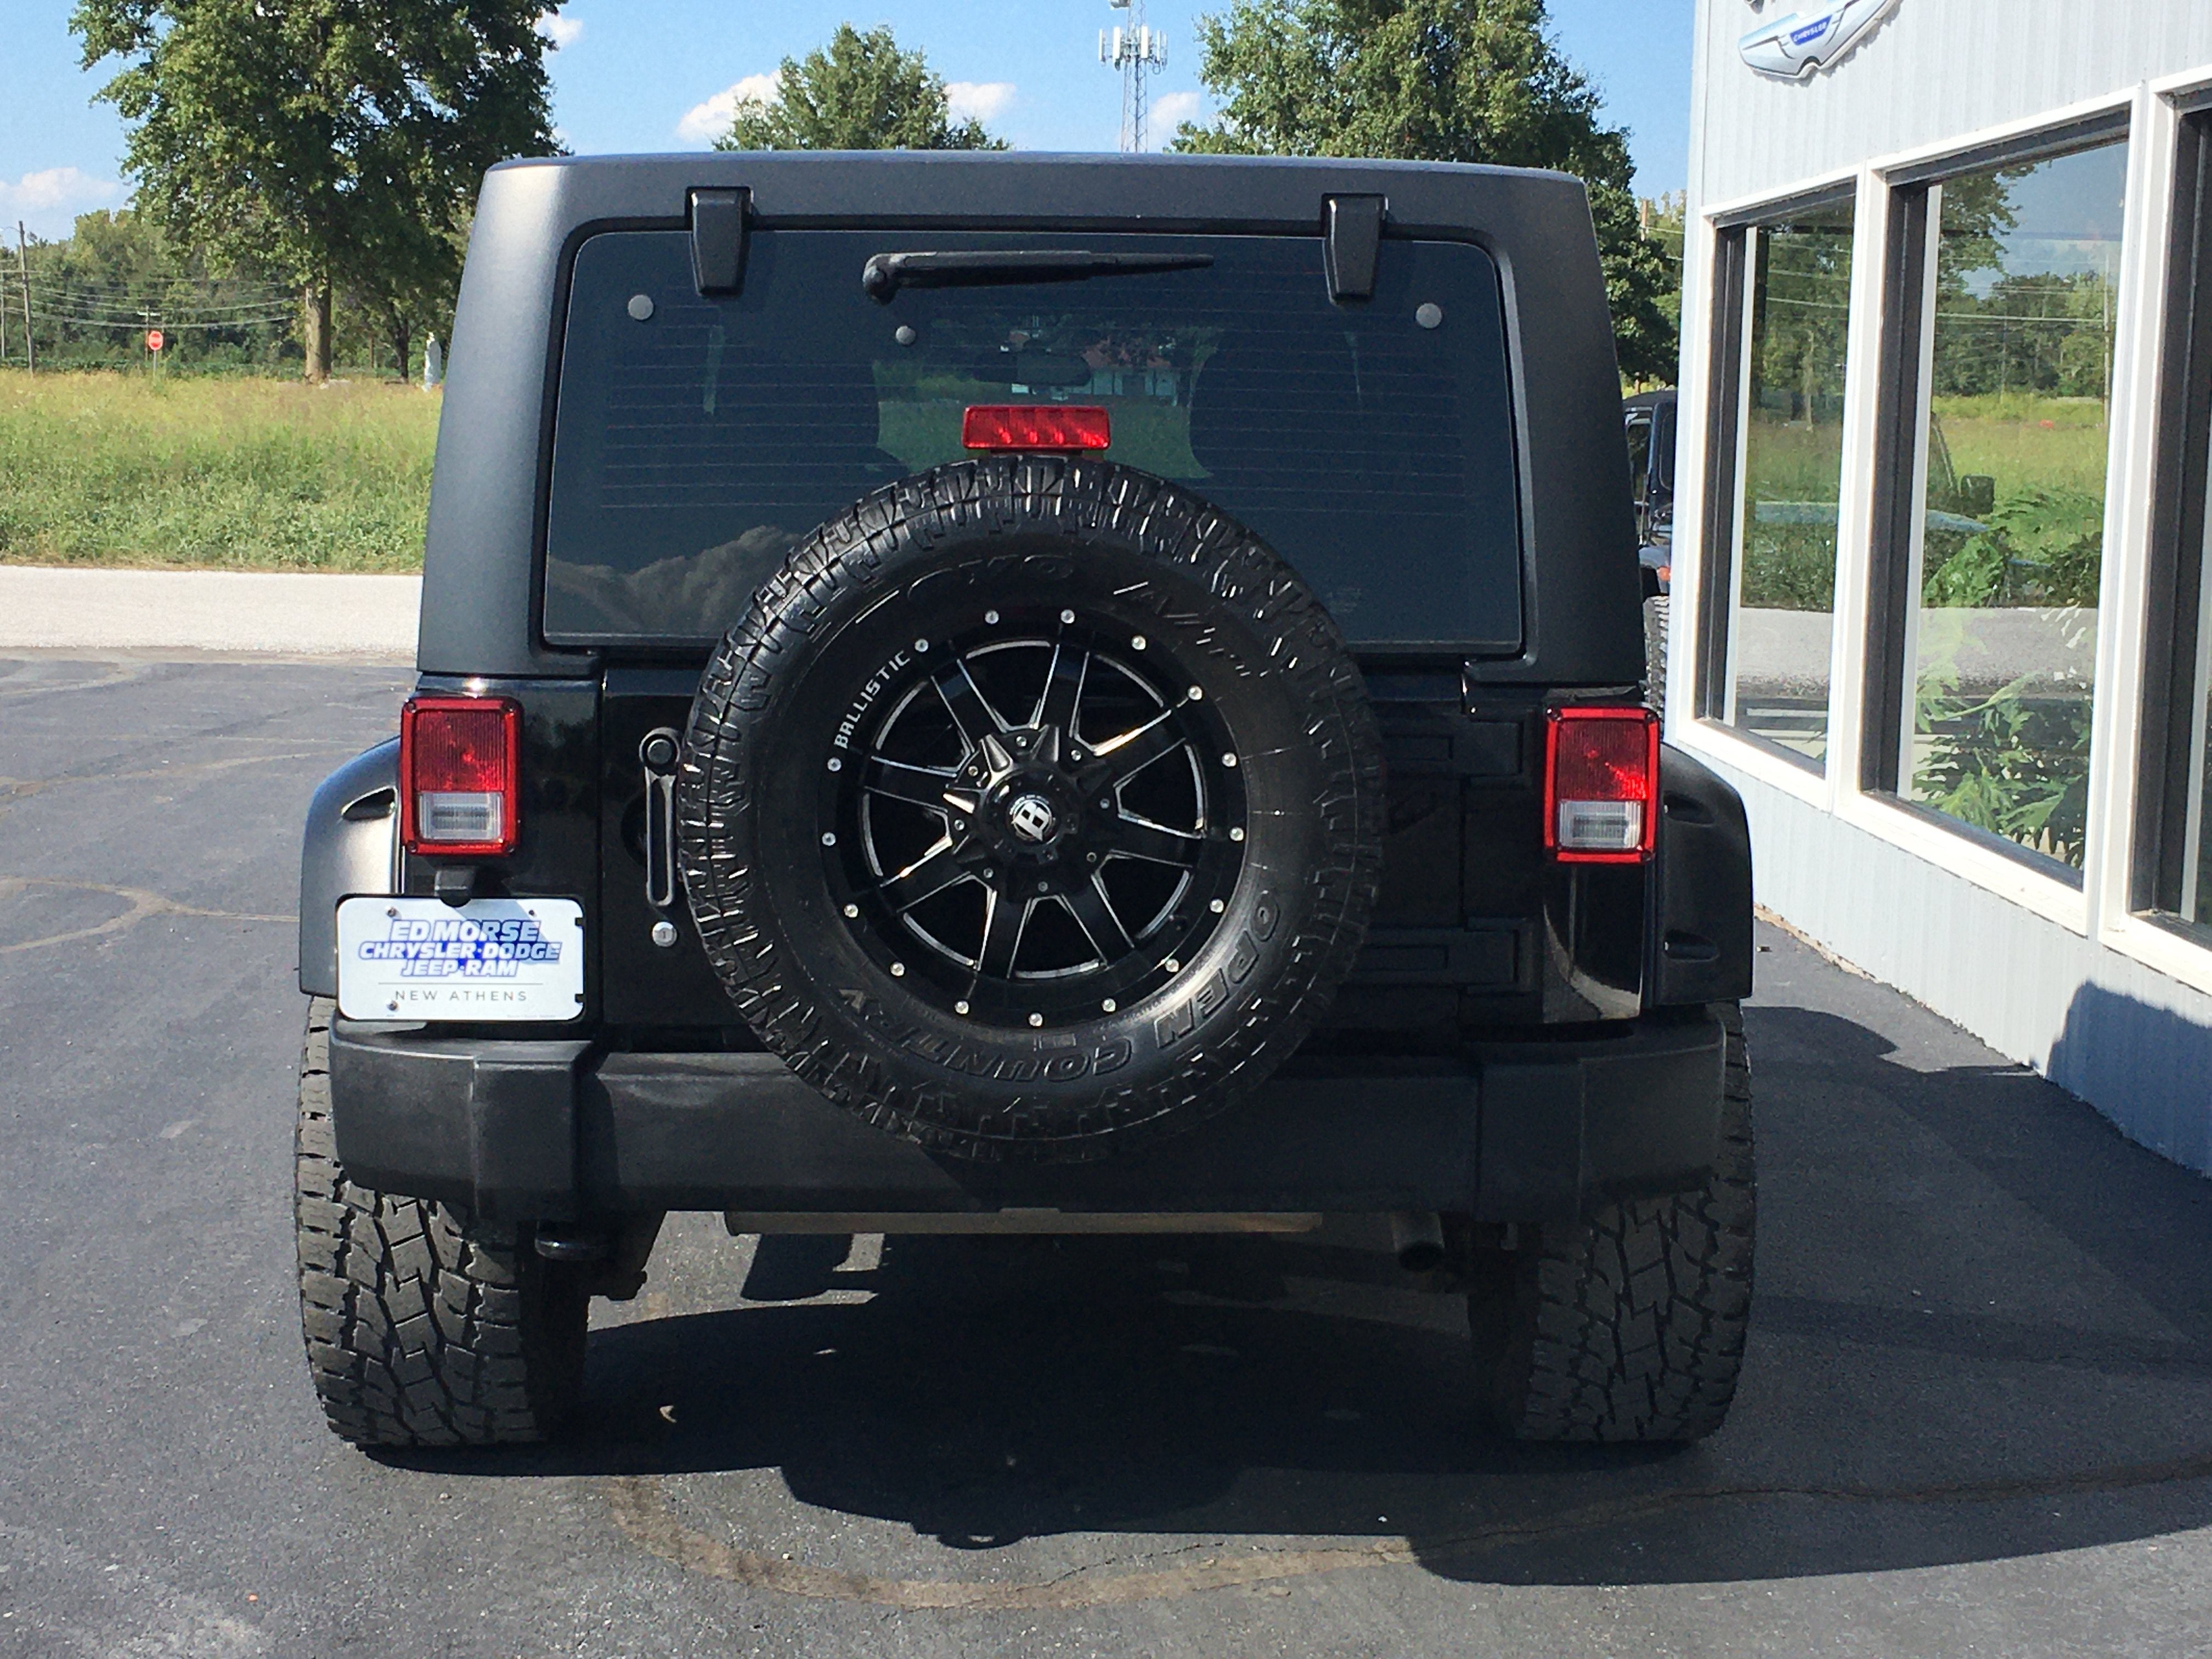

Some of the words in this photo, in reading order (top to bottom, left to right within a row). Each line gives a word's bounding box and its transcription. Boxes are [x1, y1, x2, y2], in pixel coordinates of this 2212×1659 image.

[833, 650, 911, 749] BALLISTIC
[387, 919, 431, 942] ED
[432, 919, 541, 942] MORSE
[396, 991, 437, 1001] NEW
[449, 991, 527, 1001] ATHENS
[1154, 890, 1280, 1048] OPEN
